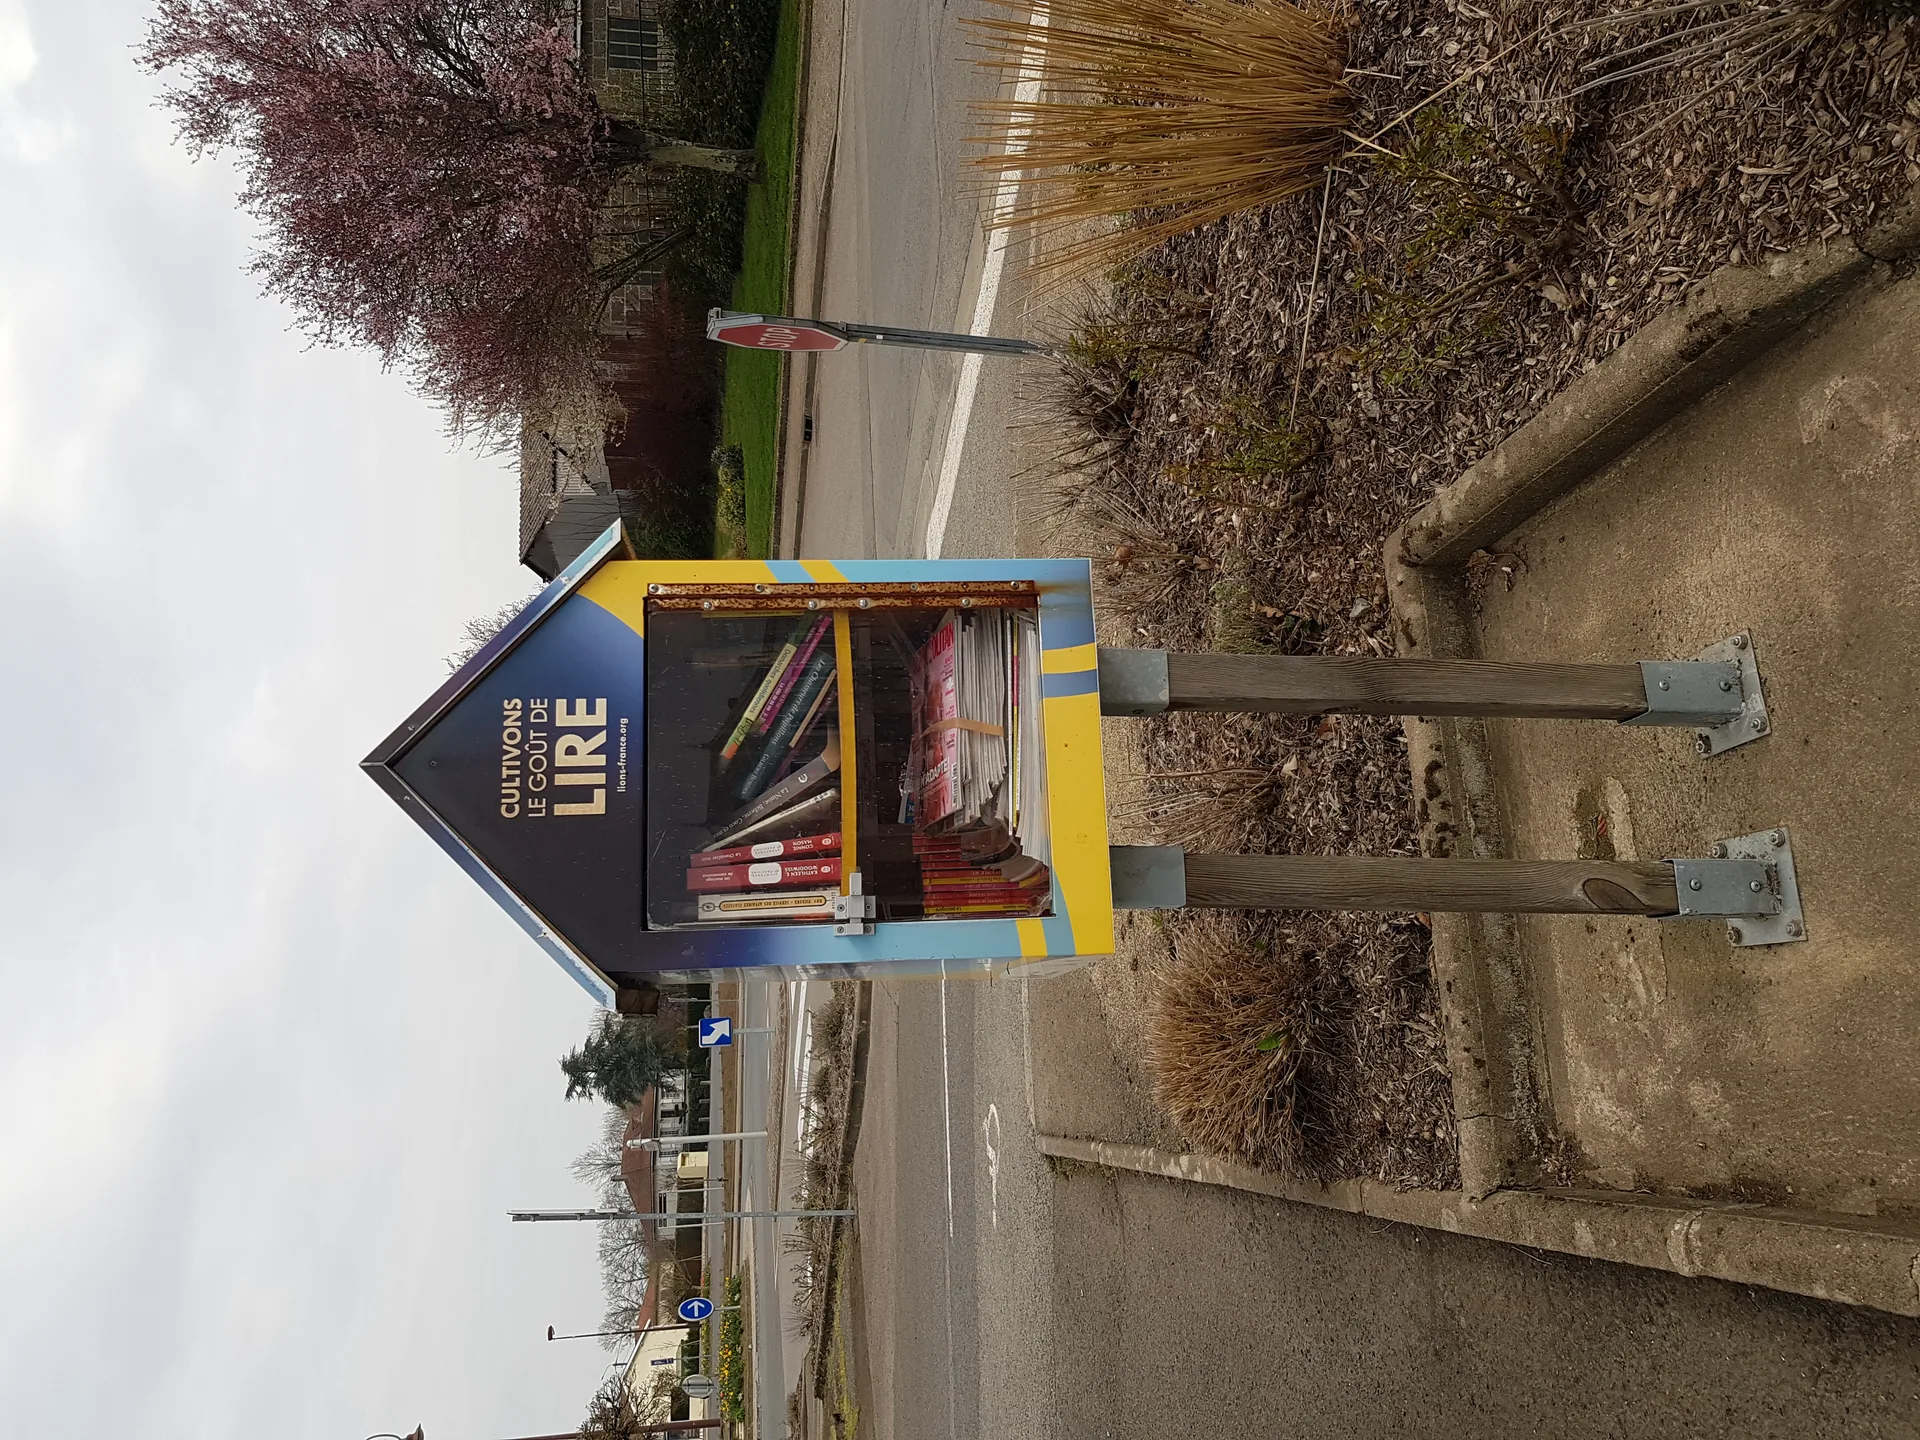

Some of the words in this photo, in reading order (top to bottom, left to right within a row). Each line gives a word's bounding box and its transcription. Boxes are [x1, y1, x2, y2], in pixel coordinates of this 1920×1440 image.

[757, 328, 800, 348] STOP
[769, 648, 791, 680] Démarches
[814, 657, 826, 672] Les
[748, 678, 773, 714] quotidiennes
[795, 669, 820, 706] Chasseurs
[530, 698, 548, 723] DE
[789, 703, 800, 715] de
[769, 711, 794, 747] Papillons
[500, 698, 523, 818] CULTIVONS
[524, 730, 548, 792] GOÛT
[553, 697, 607, 816] LIRE
[617, 717, 629, 792] lions-france.org
[779, 786, 789, 795] La
[528, 797, 546, 817] LE
[712, 853, 734, 861] Chevalier
[792, 843, 813, 851] CONNIE
